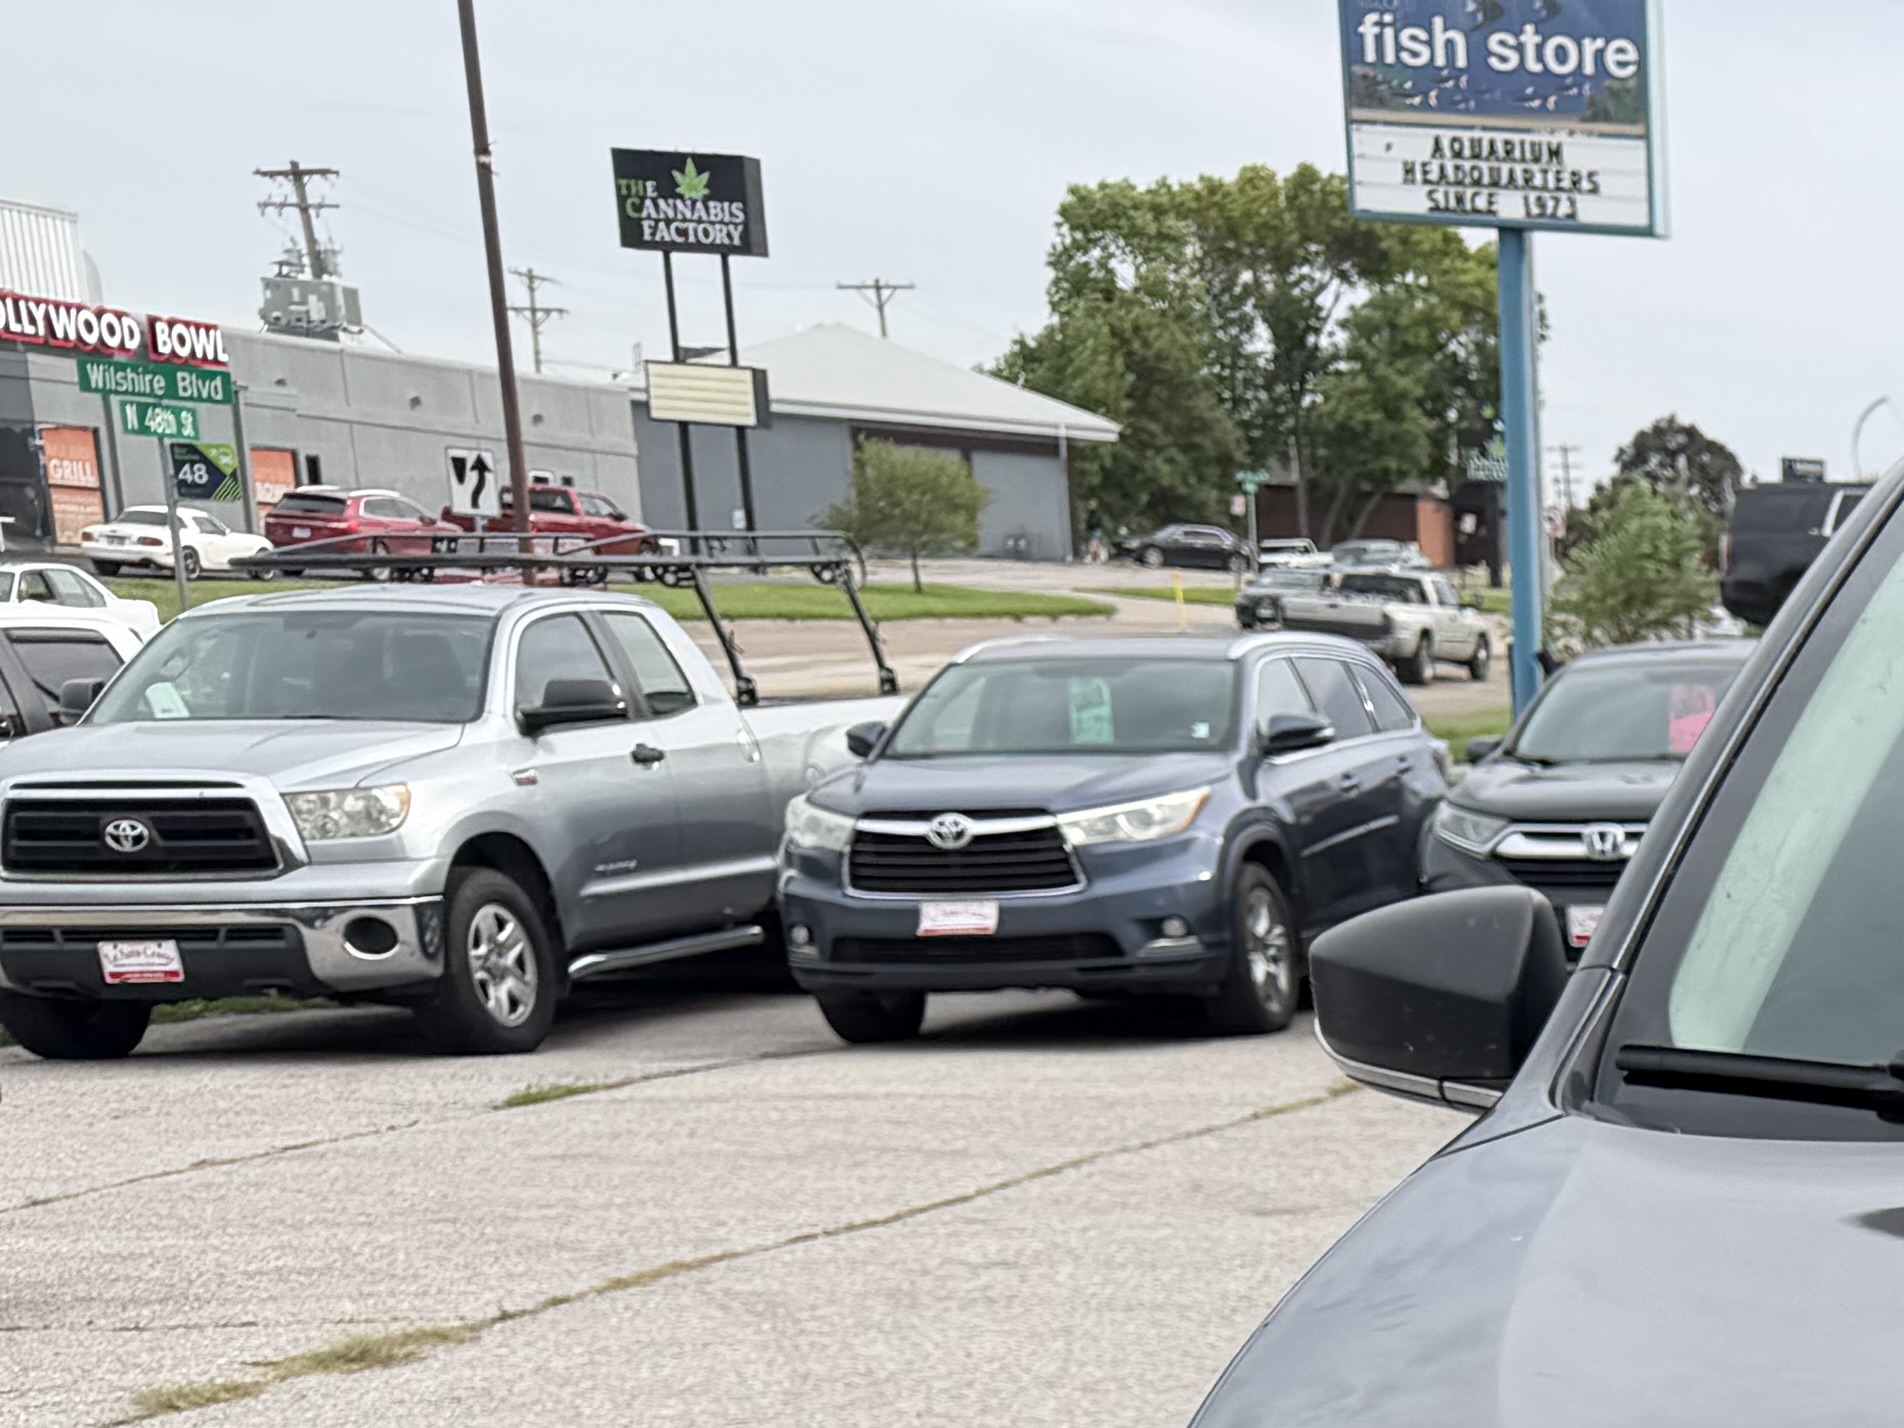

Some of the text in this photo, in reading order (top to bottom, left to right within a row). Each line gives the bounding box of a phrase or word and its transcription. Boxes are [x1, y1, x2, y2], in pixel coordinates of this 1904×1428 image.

[1357, 12, 1639, 79] fish store
[1430, 135, 1563, 165] AQUARIUM
[618, 179, 657, 197] THE
[1401, 160, 1600, 195] HEADQUARTERS
[625, 197, 746, 223] CANNABIS
[1425, 189, 1498, 215] SINCE
[641, 220, 744, 246] FACTORY
[154, 321, 229, 362] BOWL
[86, 363, 224, 400] Wilshire Blvd
[125, 404, 196, 437] N 48th St
[50, 459, 96, 481] GRILL
[178, 462, 209, 485] 48
